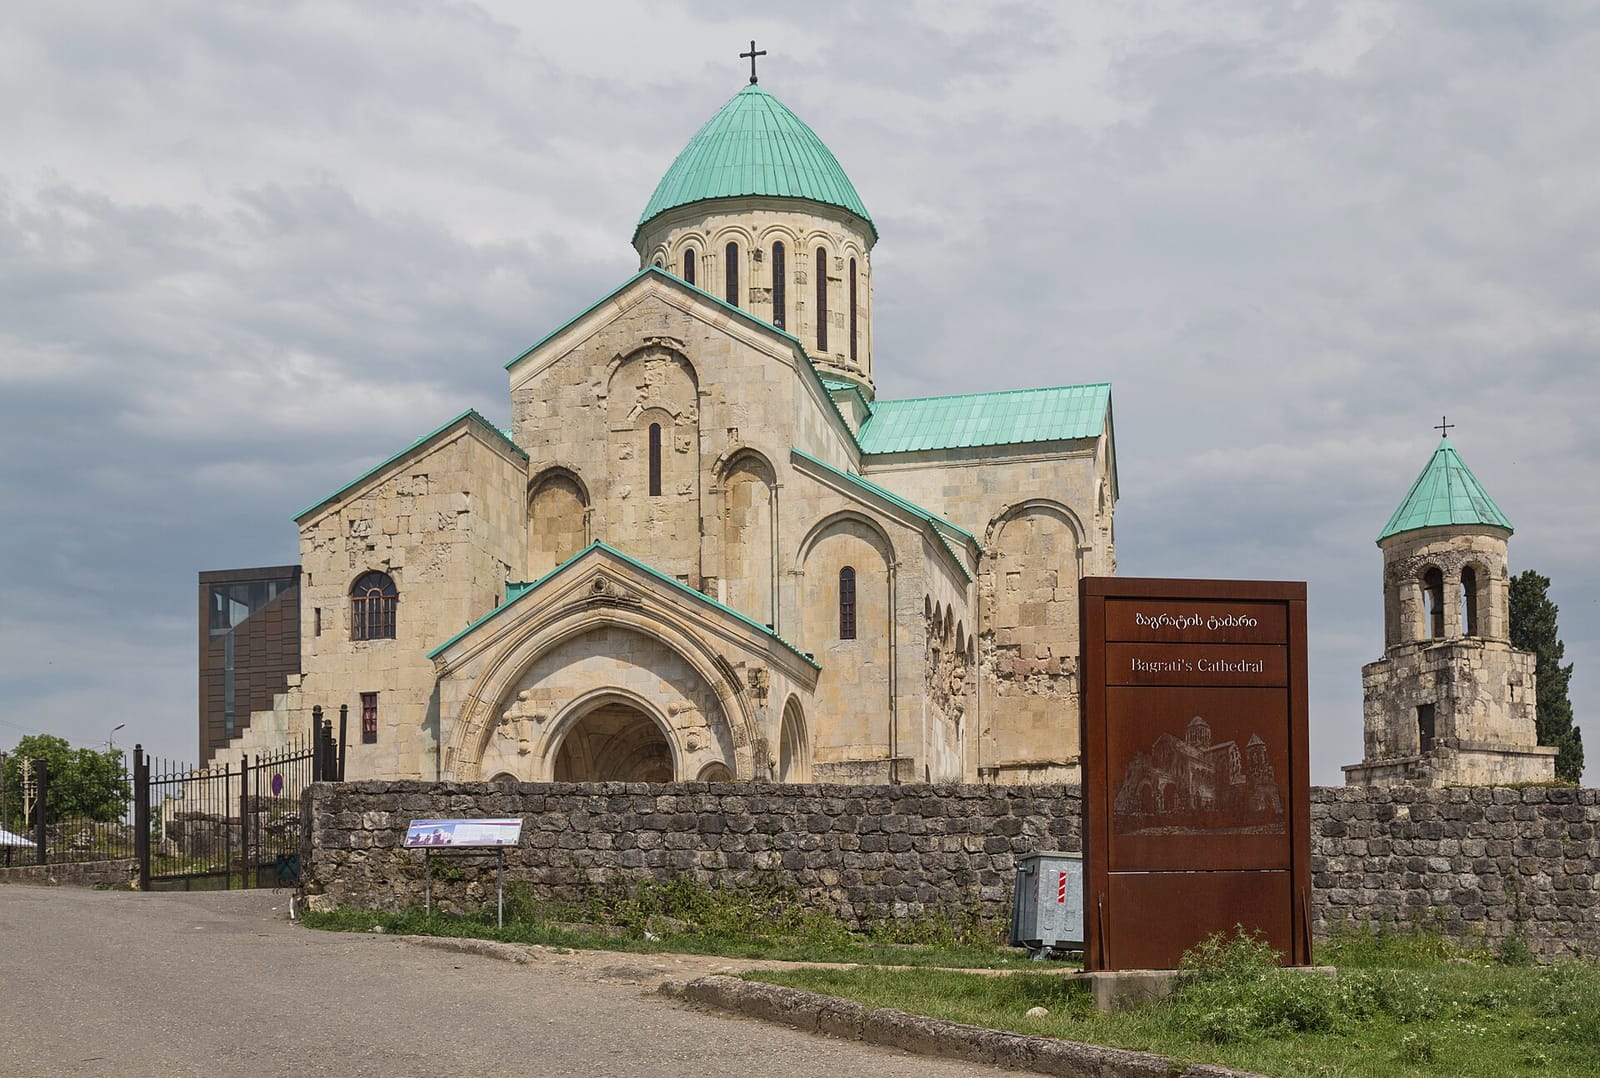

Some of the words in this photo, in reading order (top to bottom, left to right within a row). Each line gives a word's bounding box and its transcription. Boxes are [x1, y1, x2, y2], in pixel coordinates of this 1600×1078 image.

[1136, 612, 1203, 630] ბაგრატის
[1207, 614, 1257, 631] ტაძარი
[1131, 658, 1192, 673] Bagrati's
[1197, 658, 1263, 673] Cathedral
